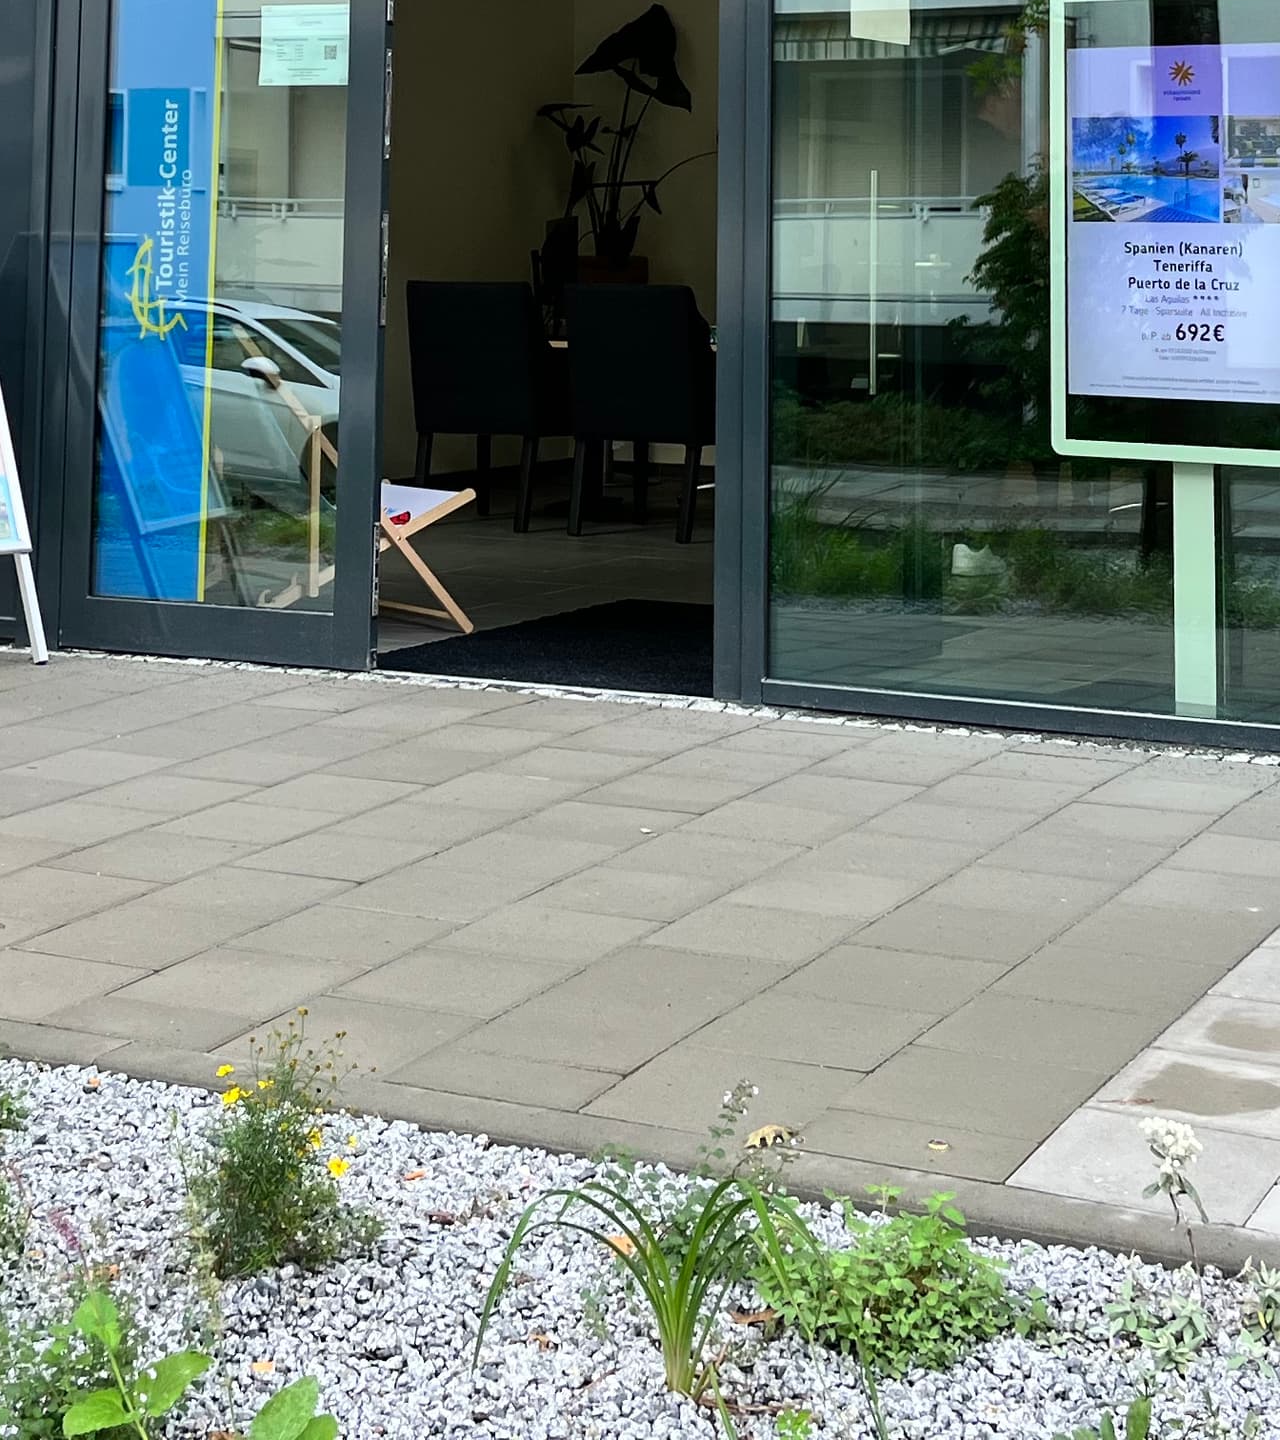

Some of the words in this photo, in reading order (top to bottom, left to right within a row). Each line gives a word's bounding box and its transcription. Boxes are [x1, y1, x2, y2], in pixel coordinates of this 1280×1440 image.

[155, 99, 179, 292] Touristik-Center
[176, 168, 192, 256] Reisebüro
[1124, 241, 1174, 256] Spanien
[1179, 241, 1243, 258] (Kanaren)
[1153, 259, 1213, 272] Teneriffa
[175, 260, 189, 305] Mein
[1128, 276, 1170, 289] Puerto
[1175, 278, 1190, 290] de
[1195, 278, 1206, 290] la
[1211, 278, 1240, 291] Cruz
